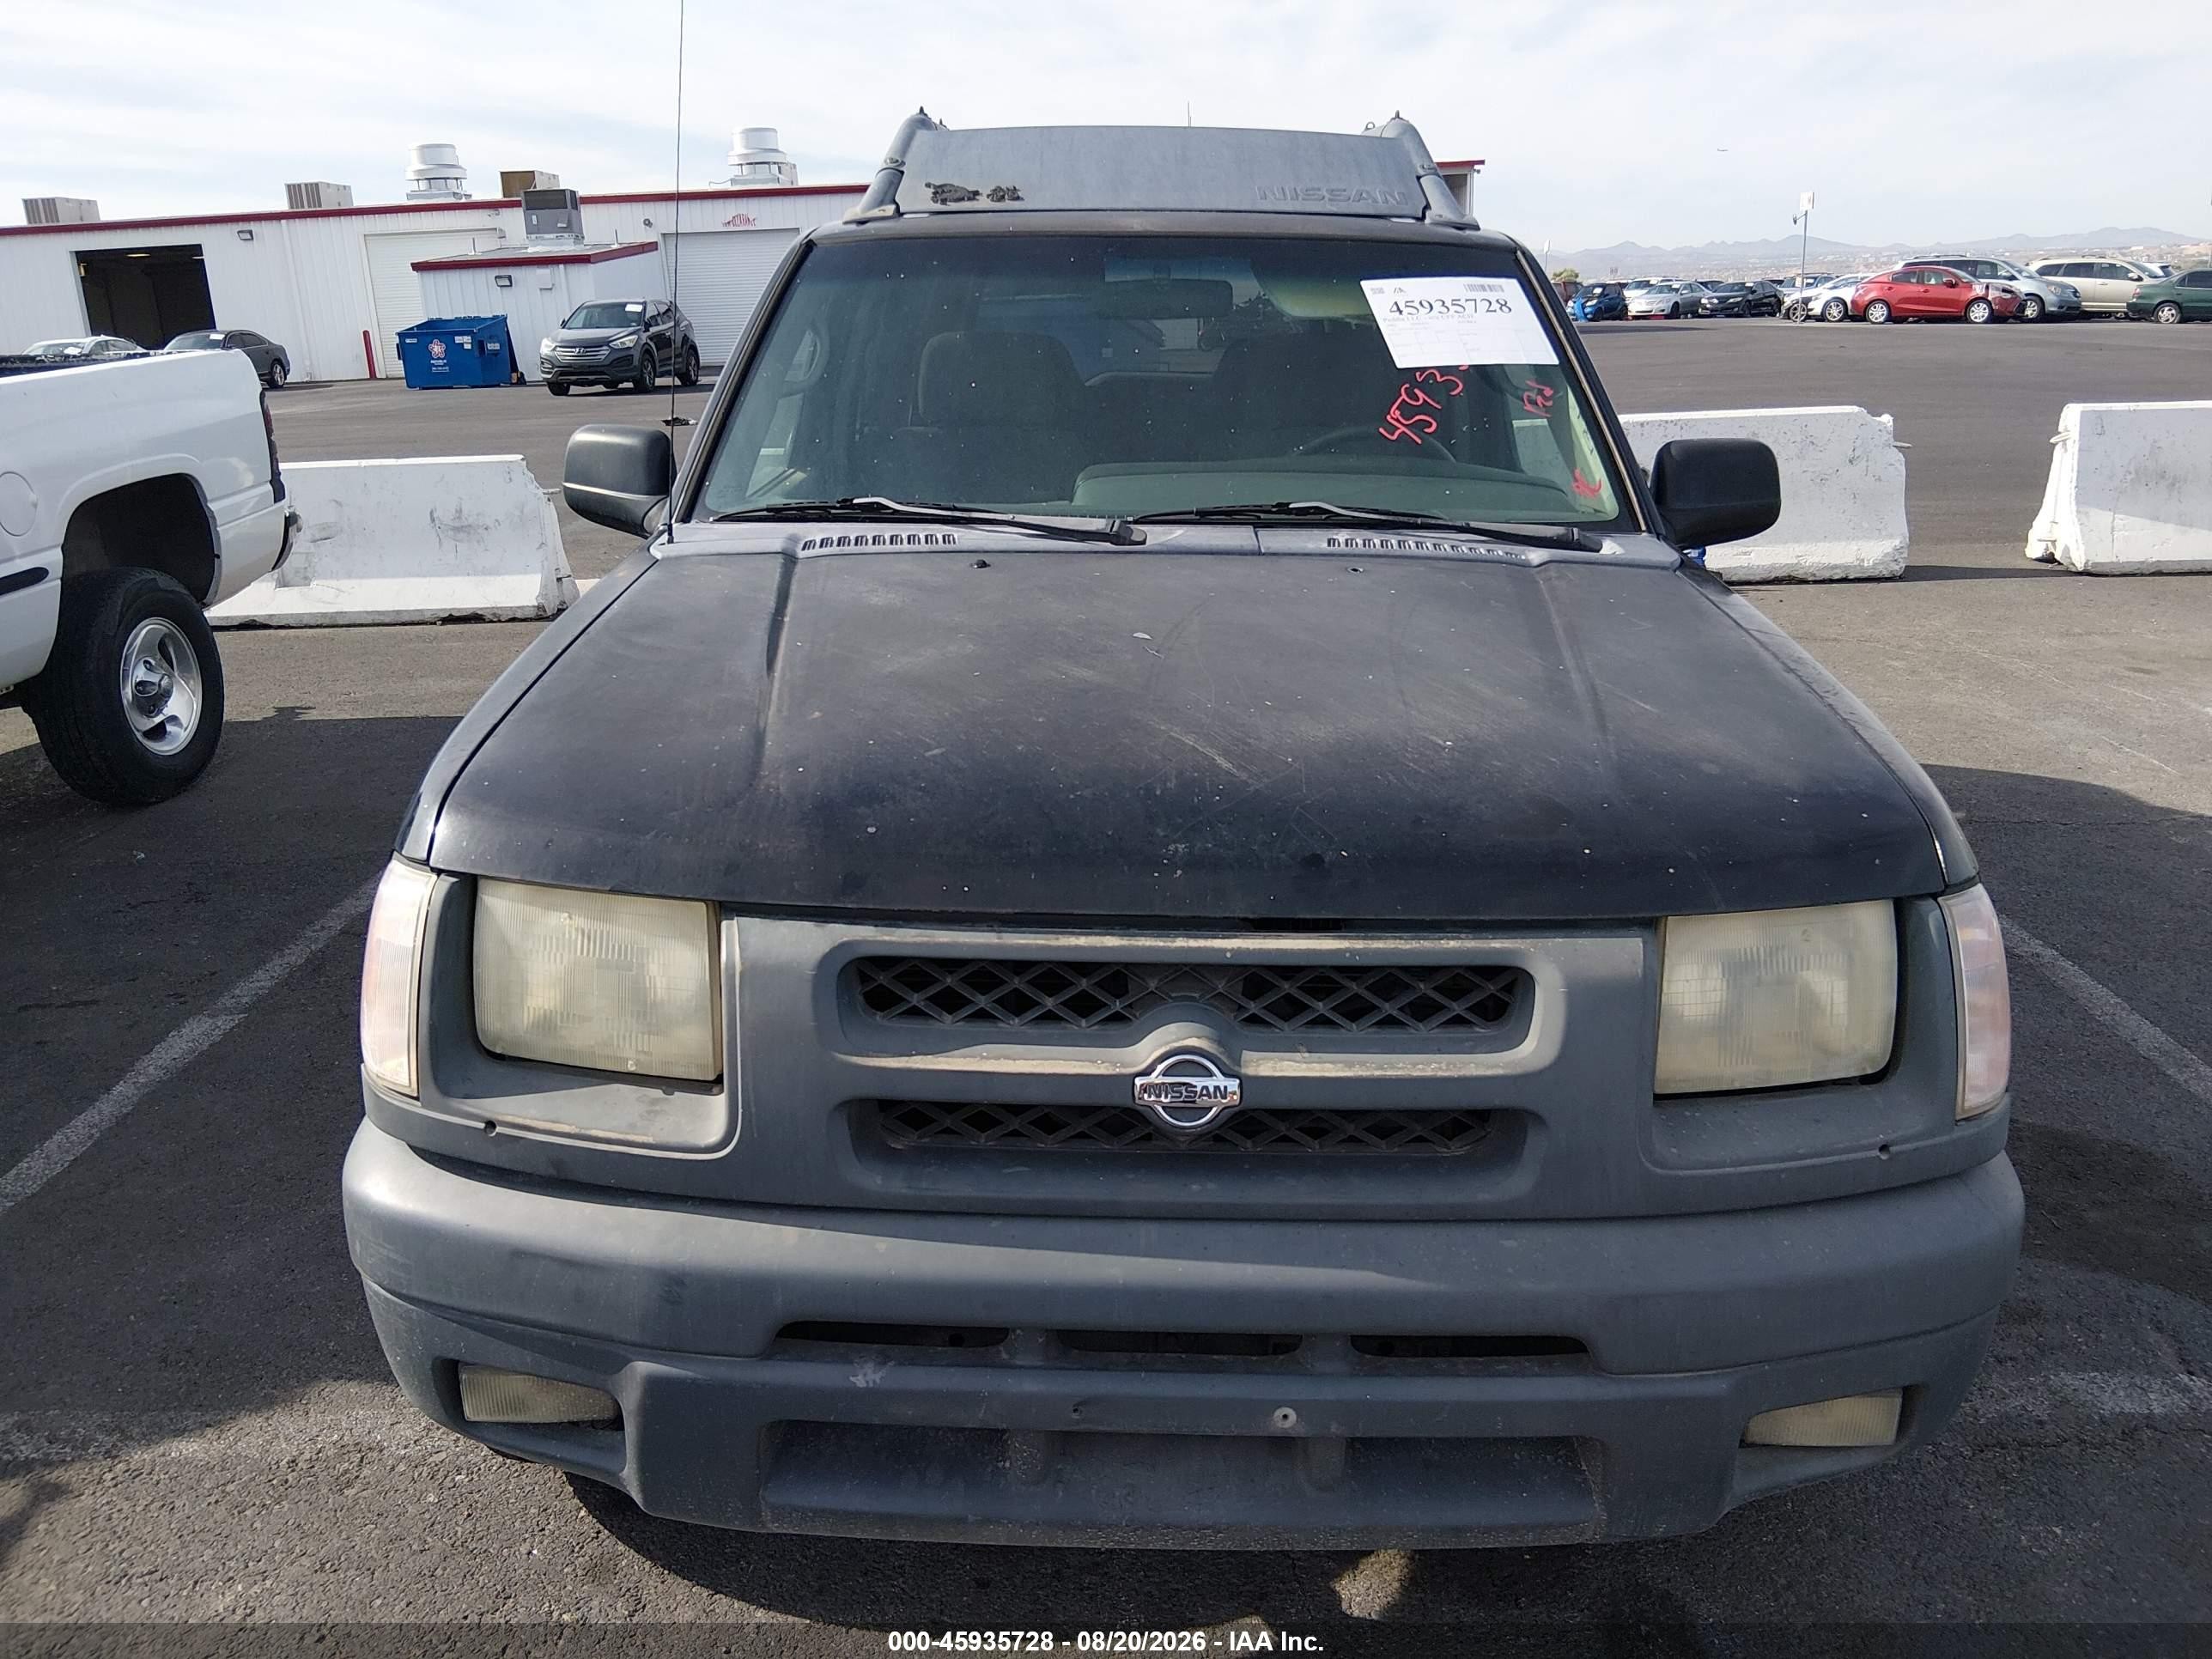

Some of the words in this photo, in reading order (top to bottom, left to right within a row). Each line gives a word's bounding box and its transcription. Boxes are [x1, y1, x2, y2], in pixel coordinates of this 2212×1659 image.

[1255, 185, 1409, 206] NISSAN
[1389, 298, 1512, 316] 45935728
[1146, 1084, 1228, 1100] NISSAN
